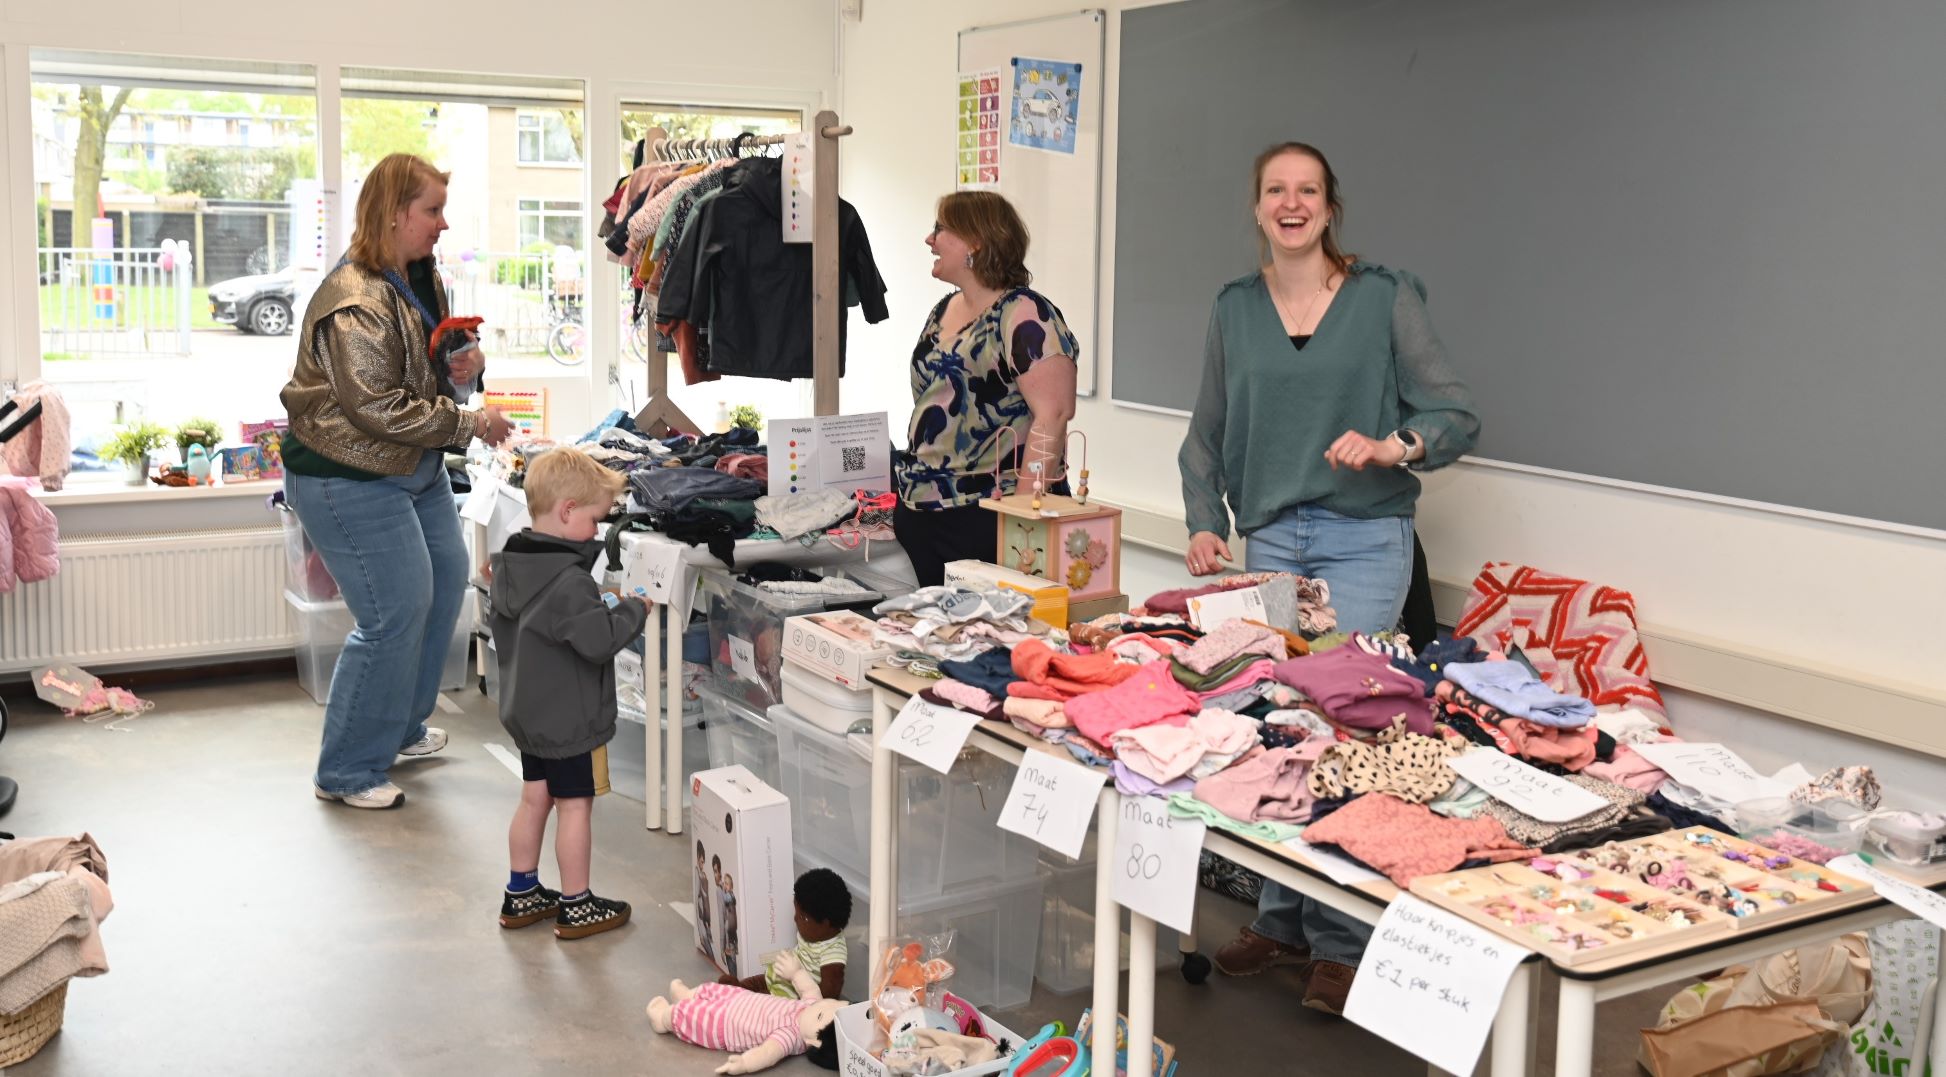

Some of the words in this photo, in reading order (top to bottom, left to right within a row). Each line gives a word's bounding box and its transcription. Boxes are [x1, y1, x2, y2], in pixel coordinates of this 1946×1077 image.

[901, 720, 935, 746] 62
[1675, 754, 1721, 776] 110
[1483, 775, 1533, 802] 92
[1023, 793, 1048, 835] 74
[1127, 843, 1161, 879] 80
[1483, 945, 1499, 958] en
[1408, 976, 1431, 991] per
[1438, 987, 1471, 1013] stuk
